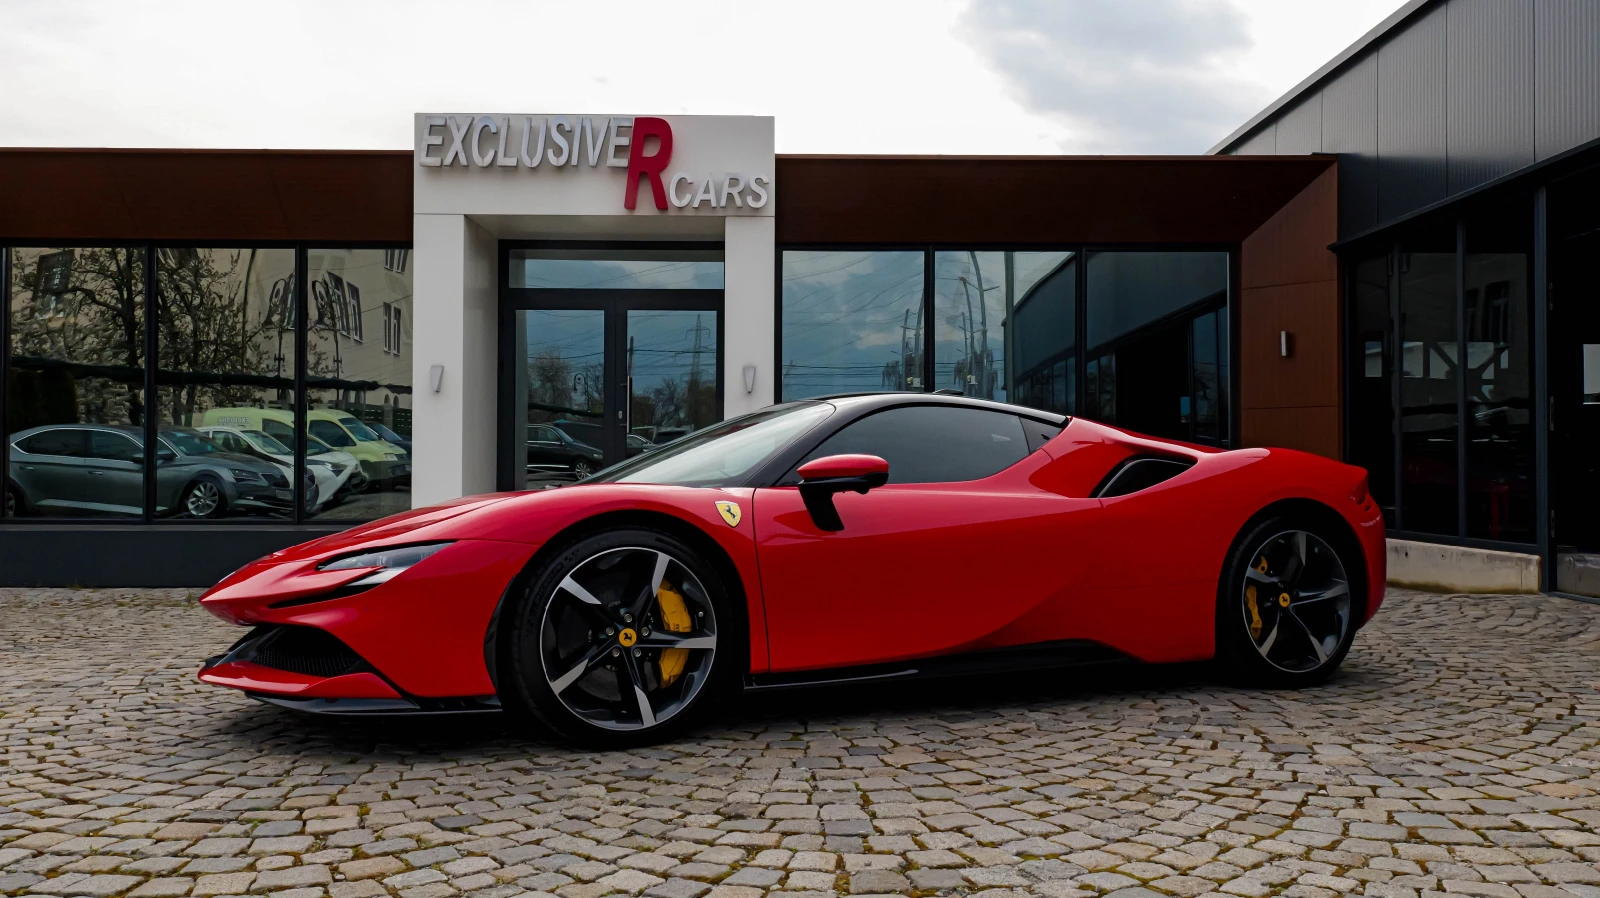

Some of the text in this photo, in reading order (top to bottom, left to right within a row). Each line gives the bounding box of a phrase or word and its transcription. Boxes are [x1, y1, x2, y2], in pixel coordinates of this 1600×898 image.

[419, 116, 674, 210] EXCLUSIVE R
[669, 172, 769, 209] CARS
